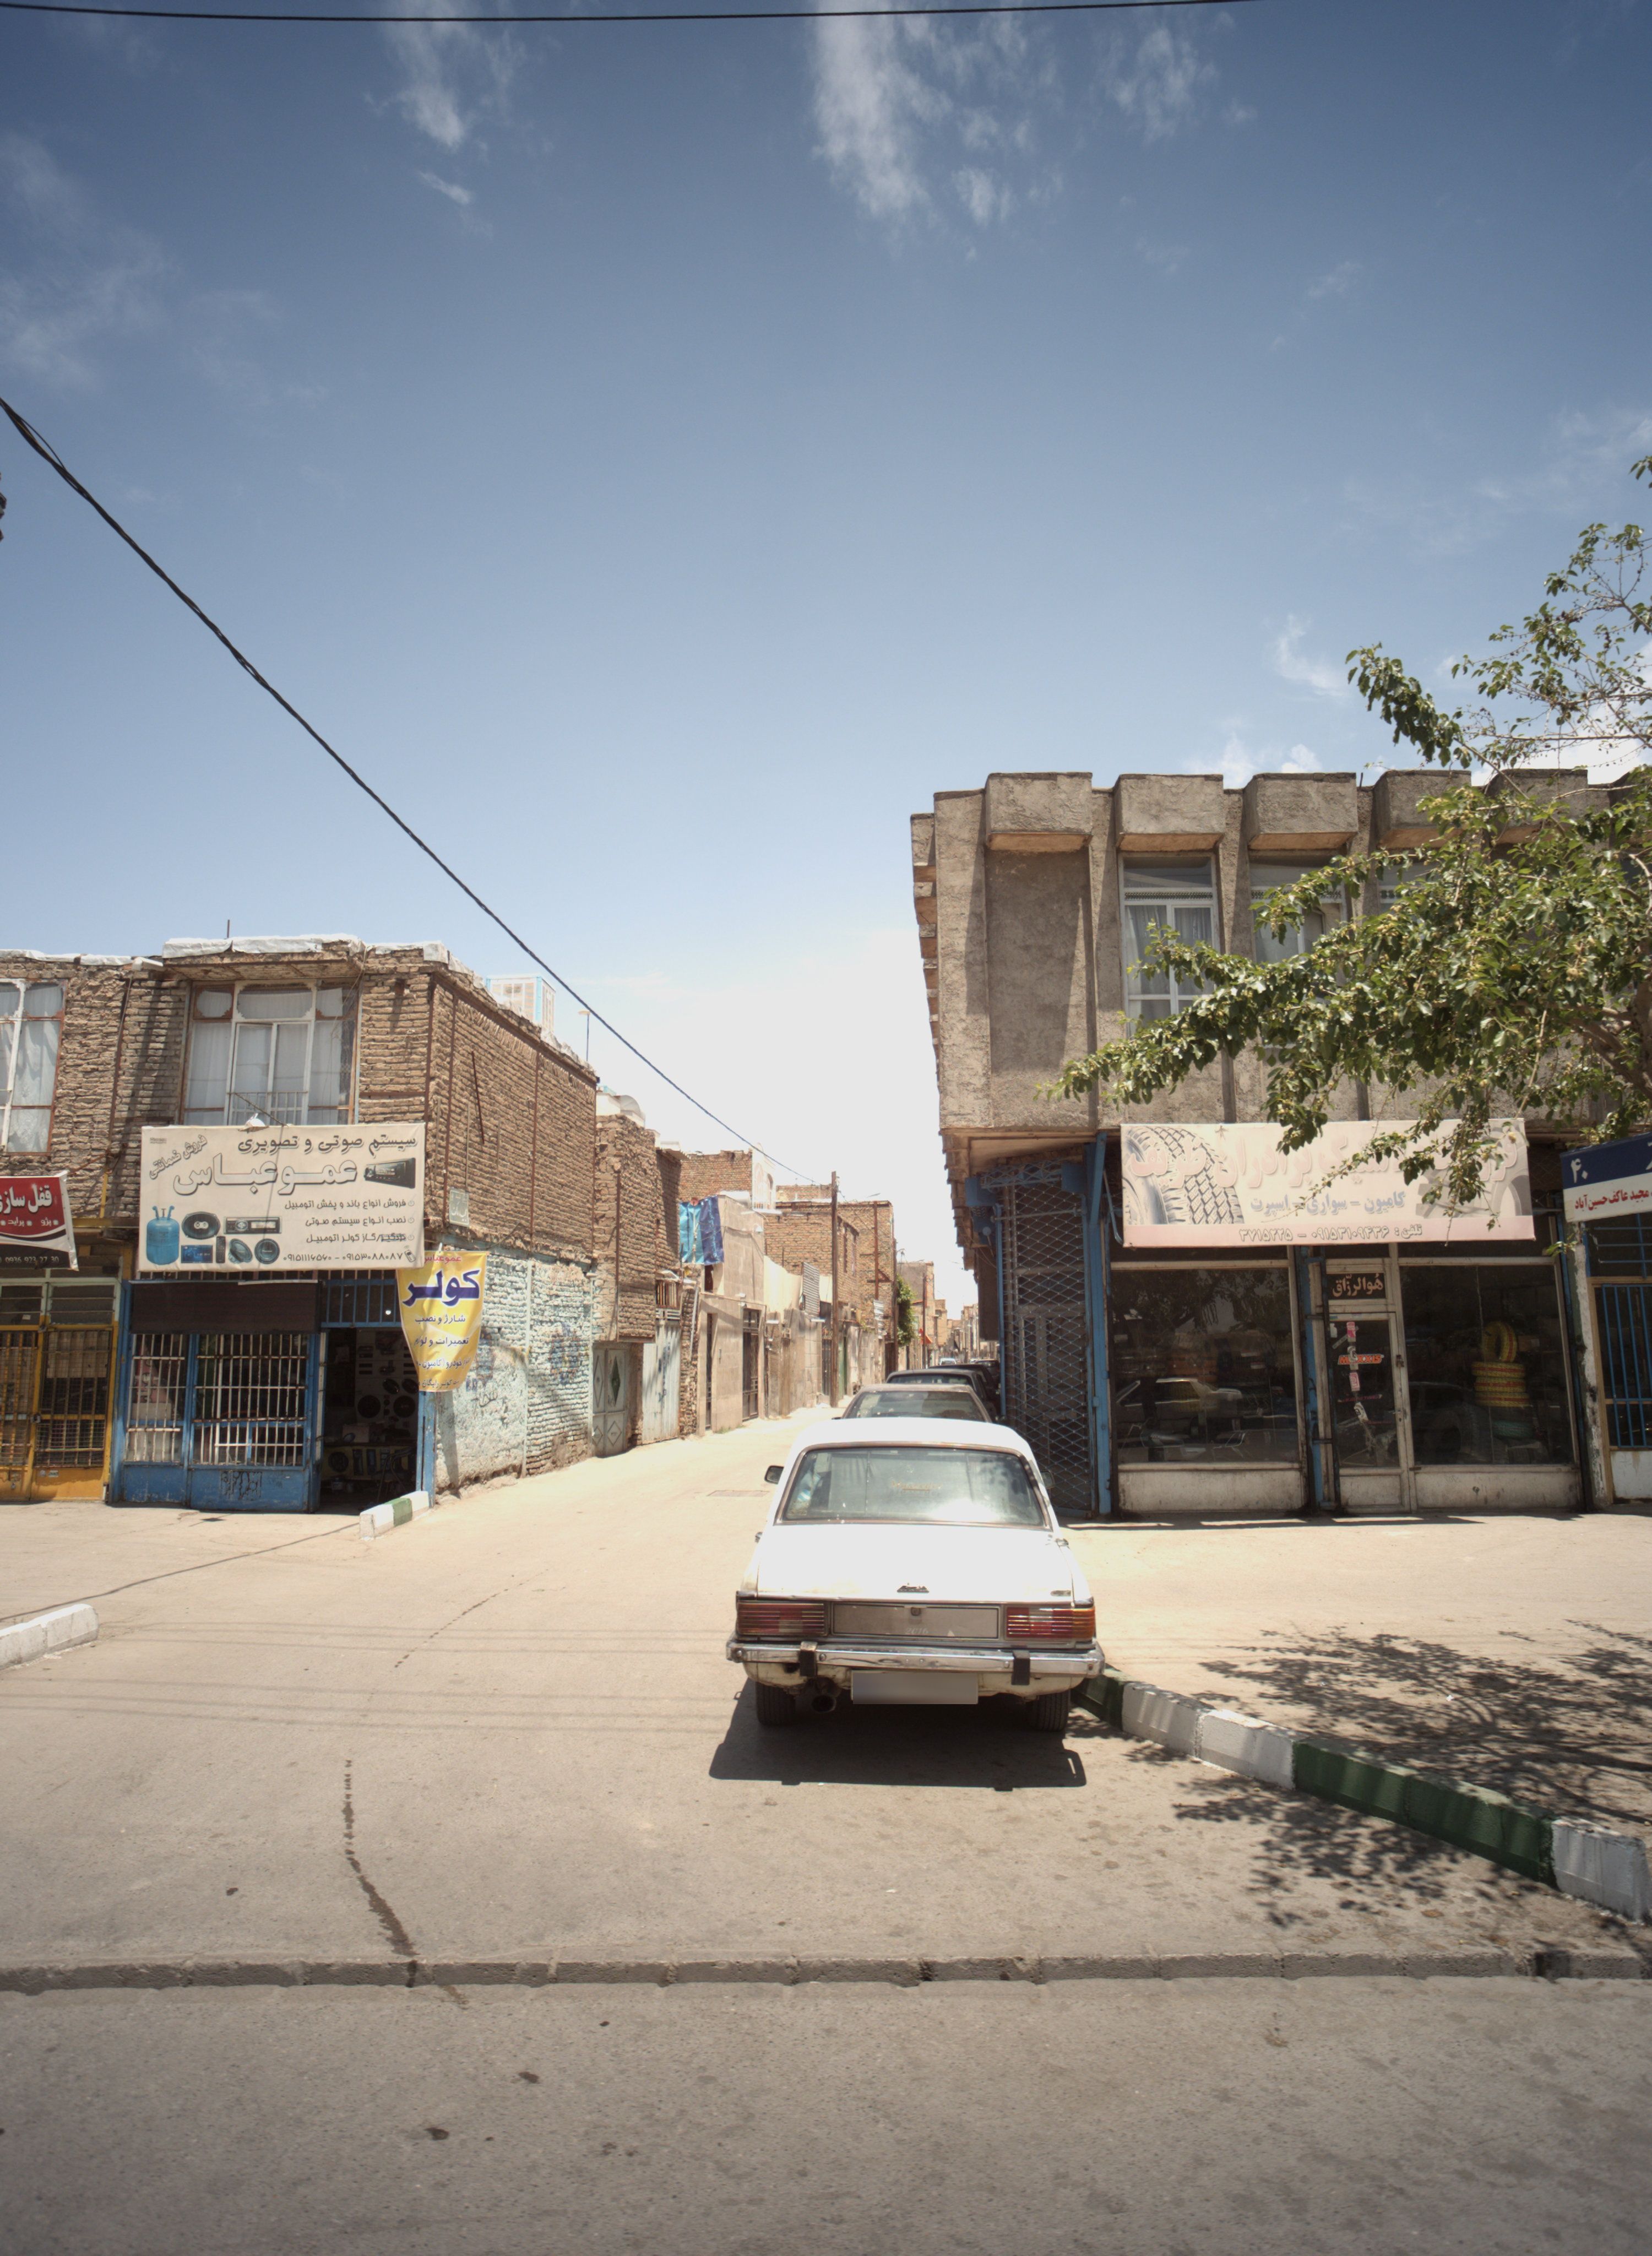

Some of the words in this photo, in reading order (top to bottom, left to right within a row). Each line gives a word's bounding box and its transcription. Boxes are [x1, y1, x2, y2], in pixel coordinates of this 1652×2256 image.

[183, 1134, 208, 1160] فروش
[237, 1136, 300, 1156] تصویری
[304, 1137, 313, 1154] و
[318, 1135, 363, 1155] صوتی
[368, 1135, 417, 1158] سیستم
[149, 1149, 182, 1180] ضمانتی
[0, 1186, 25, 1214] ساز
[28, 1183, 53, 1213] قفل
[346, 1198, 360, 1208] باند
[383, 1198, 406, 1208] فروش
[1364, 1191, 1406, 1213] کامیون
[284, 1200, 314, 1210] اتومبیل
[316, 1199, 337, 1211] پخش
[362, 1199, 382, 1210] انواع
[1306, 1192, 1348, 1216] سواری
[40, 1216, 52, 1227] پژو
[305, 1217, 329, 1227] صوتی
[332, 1218, 360, 1227] سیستم
[362, 1216, 384, 1227] انواع
[386, 1217, 406, 1225] نصب
[306, 1234, 339, 1244] اتومبیل
[341, 1233, 360, 1243] کولر
[402, 1270, 480, 1306] کولر
[415, 1315, 436, 1324] نصب
[444, 1314, 466, 1324] شارژ
[436, 1337, 469, 1347] تعمیرات
[1339, 1354, 1382, 1364] MXXIS
